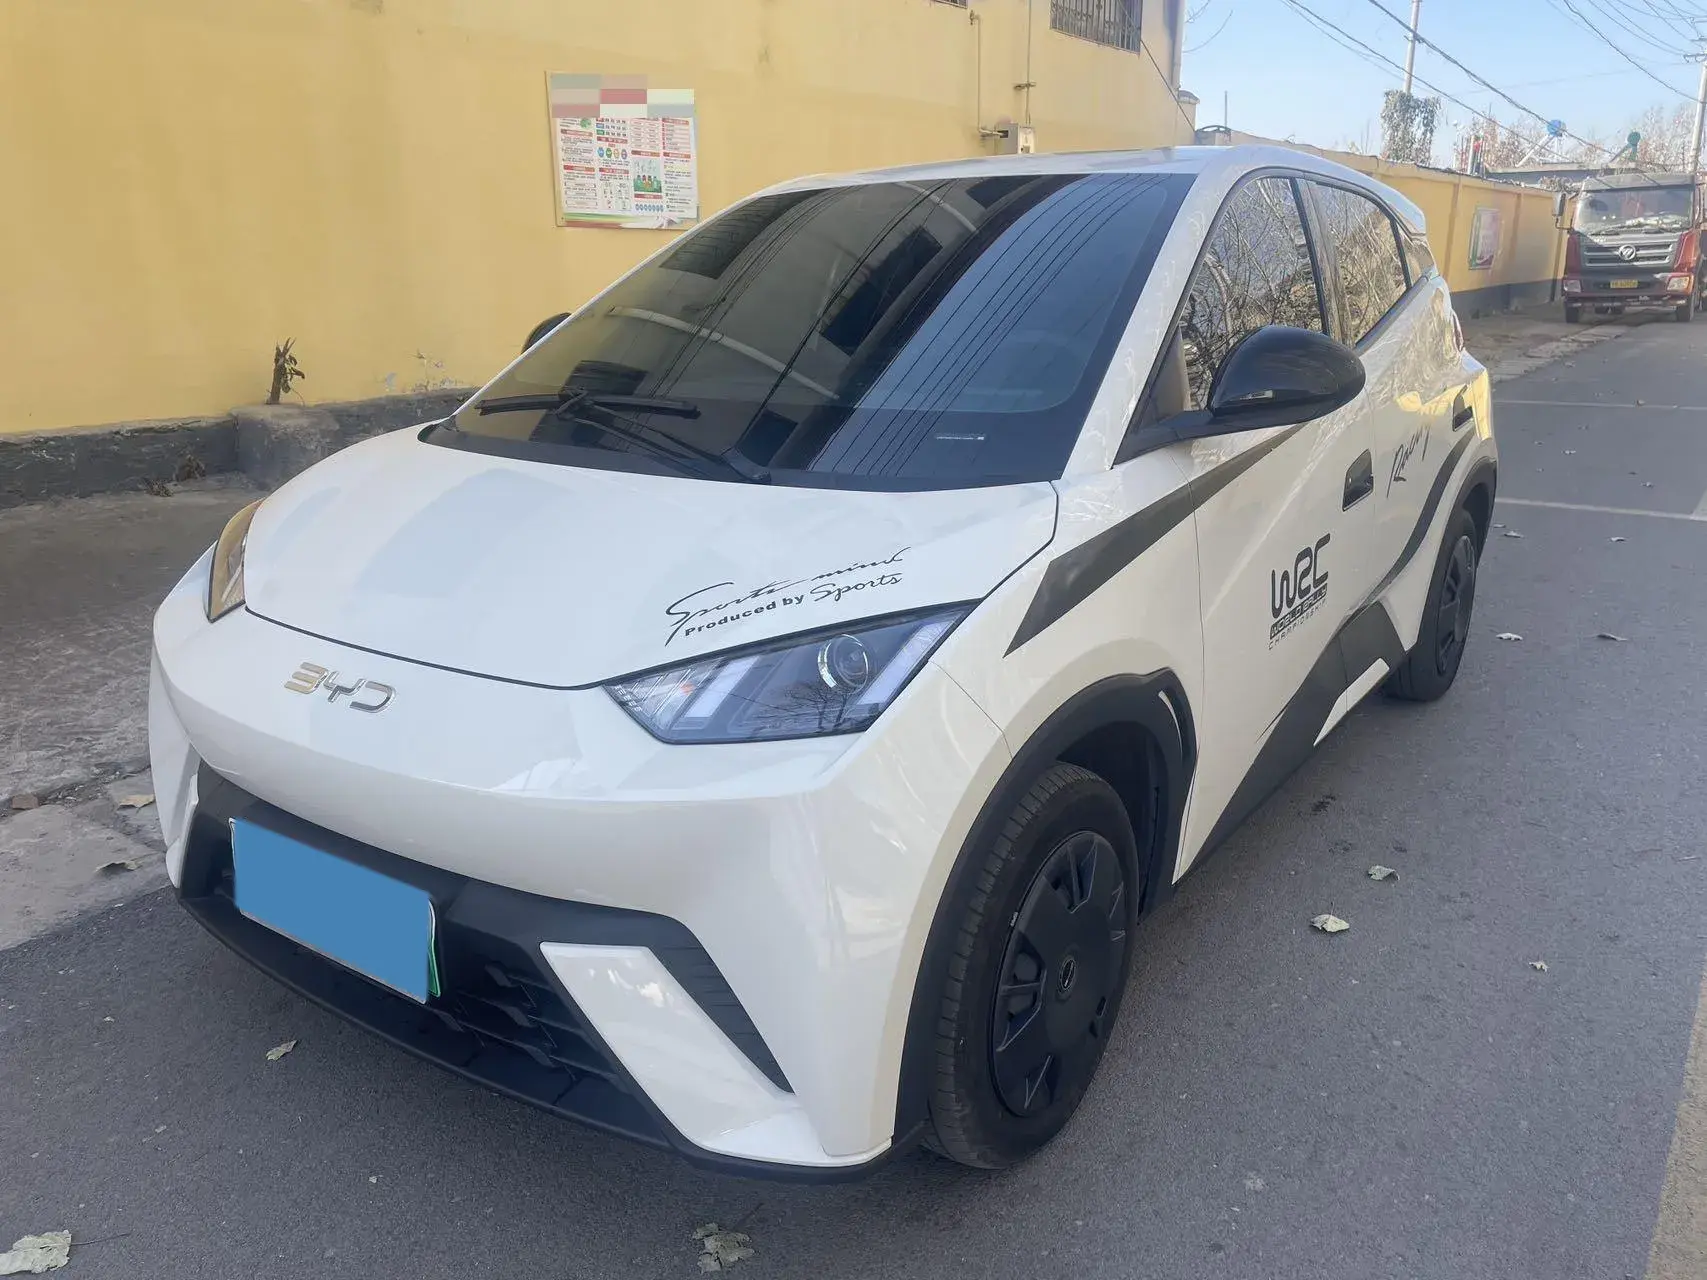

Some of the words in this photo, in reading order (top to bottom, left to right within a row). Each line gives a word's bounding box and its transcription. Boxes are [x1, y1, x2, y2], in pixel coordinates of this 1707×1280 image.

[811, 546, 911, 582] mind
[1271, 533, 1331, 619] WRC
[684, 601, 777, 637] Produced
[782, 592, 805, 607] by
[809, 572, 903, 602] Sports
[284, 661, 397, 714] BYD
